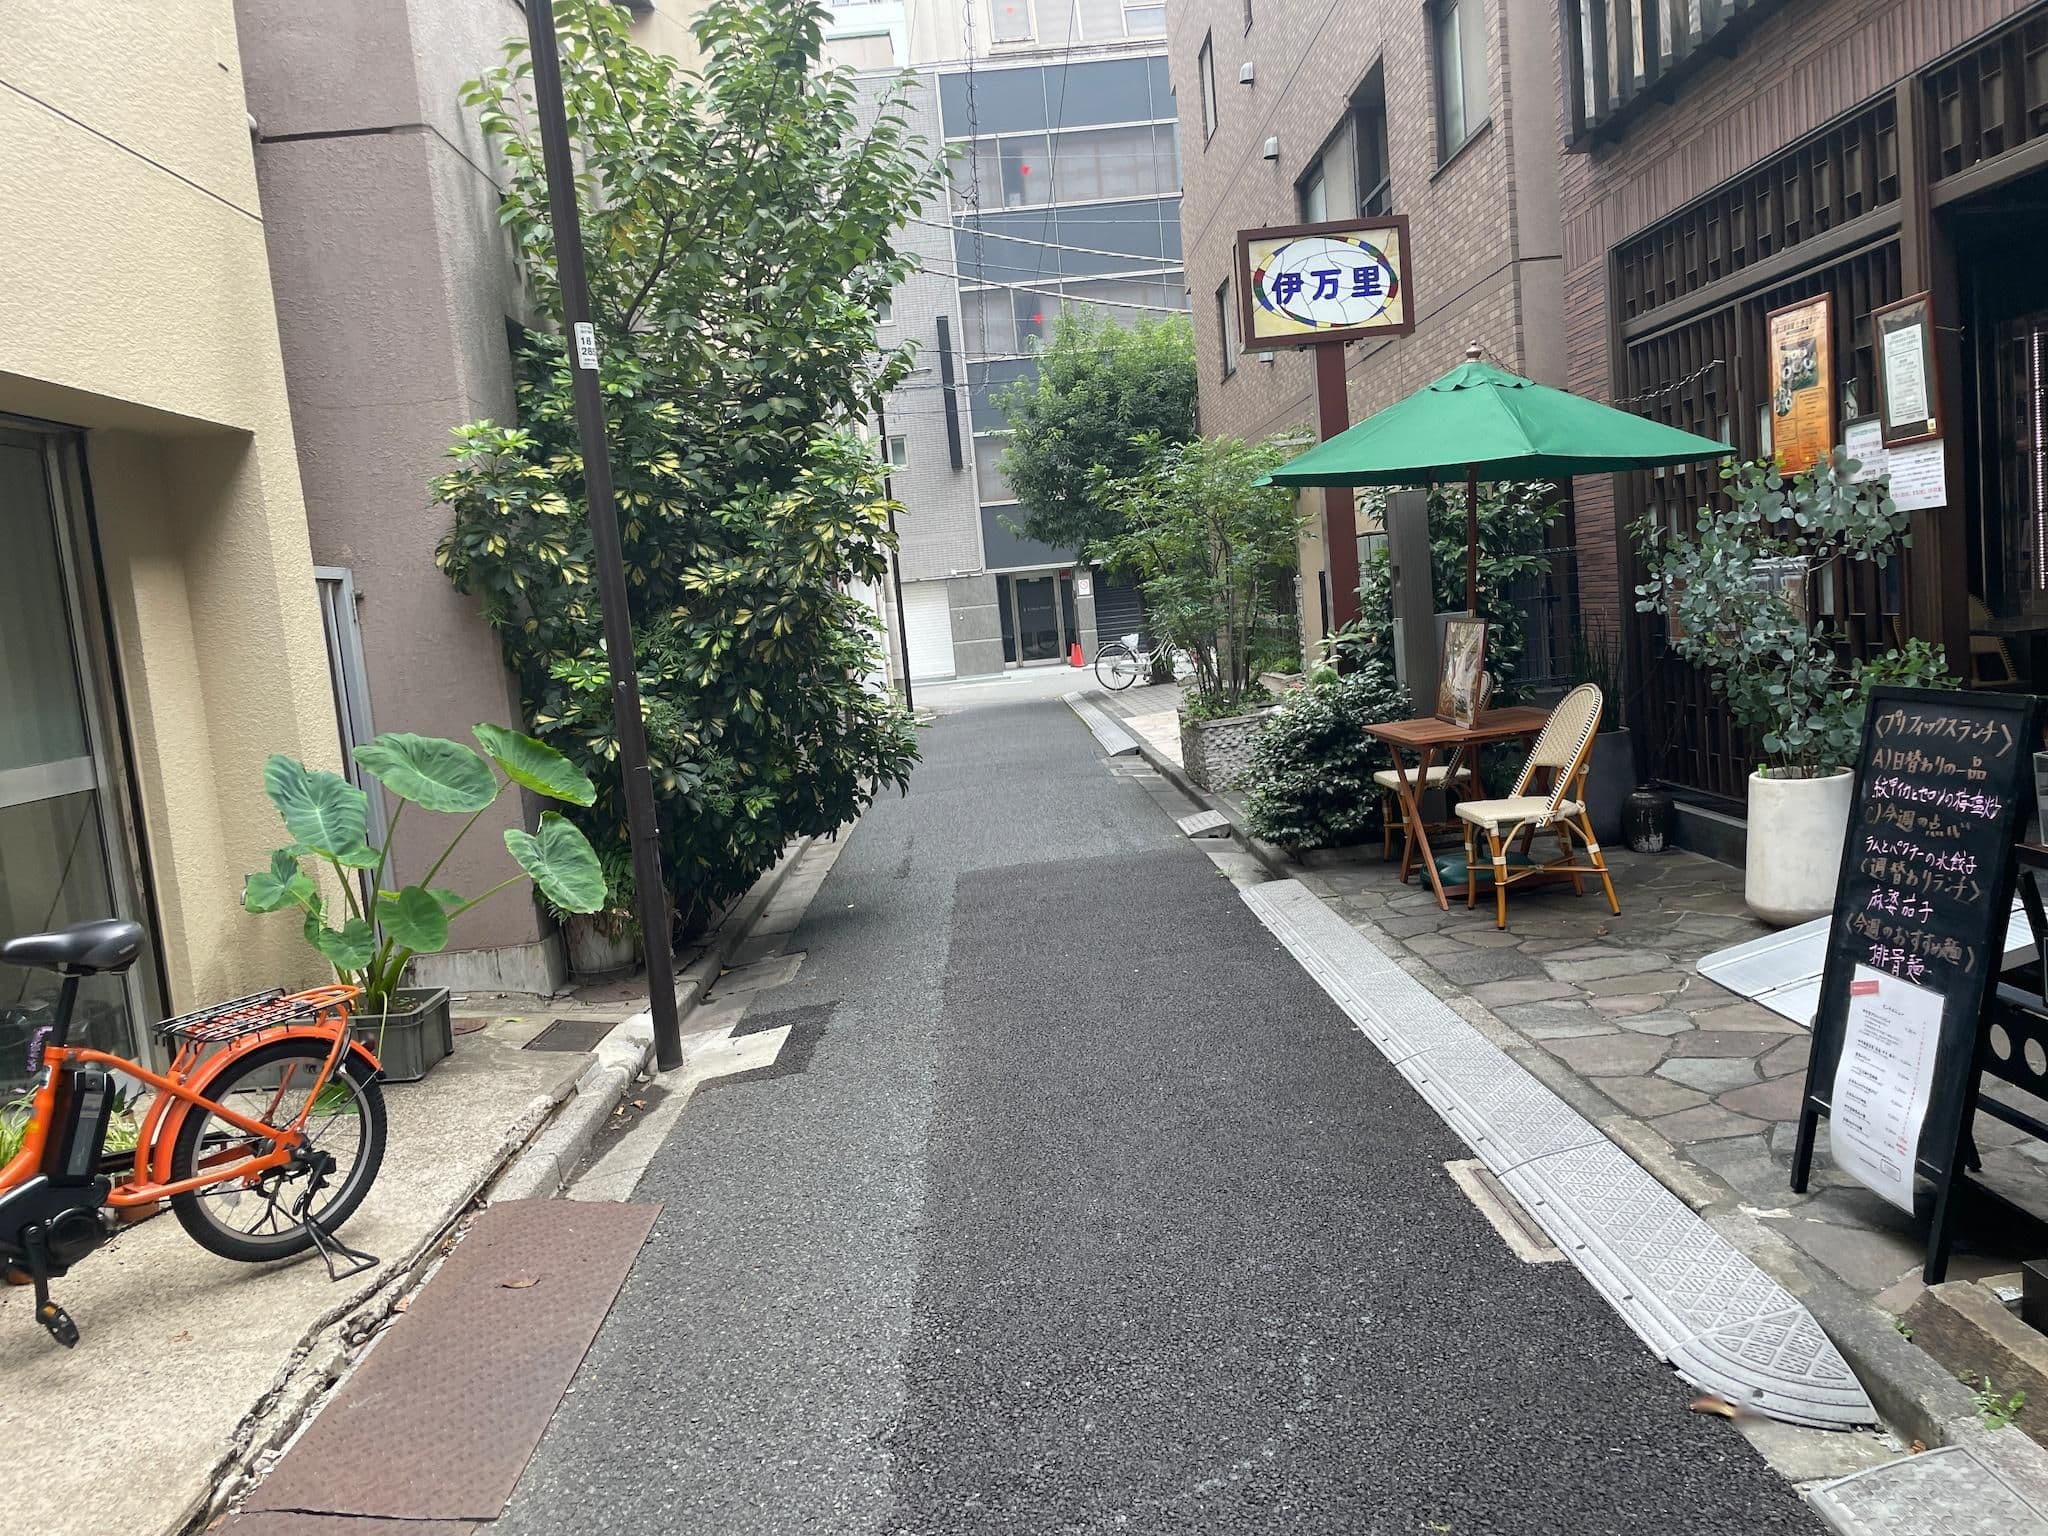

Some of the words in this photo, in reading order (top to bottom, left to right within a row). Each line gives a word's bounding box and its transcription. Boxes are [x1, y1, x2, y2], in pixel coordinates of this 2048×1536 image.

[1866, 883, 1934, 924] 麻婆茄子
[1271, 1265, 1383, 1305] 伊万里
